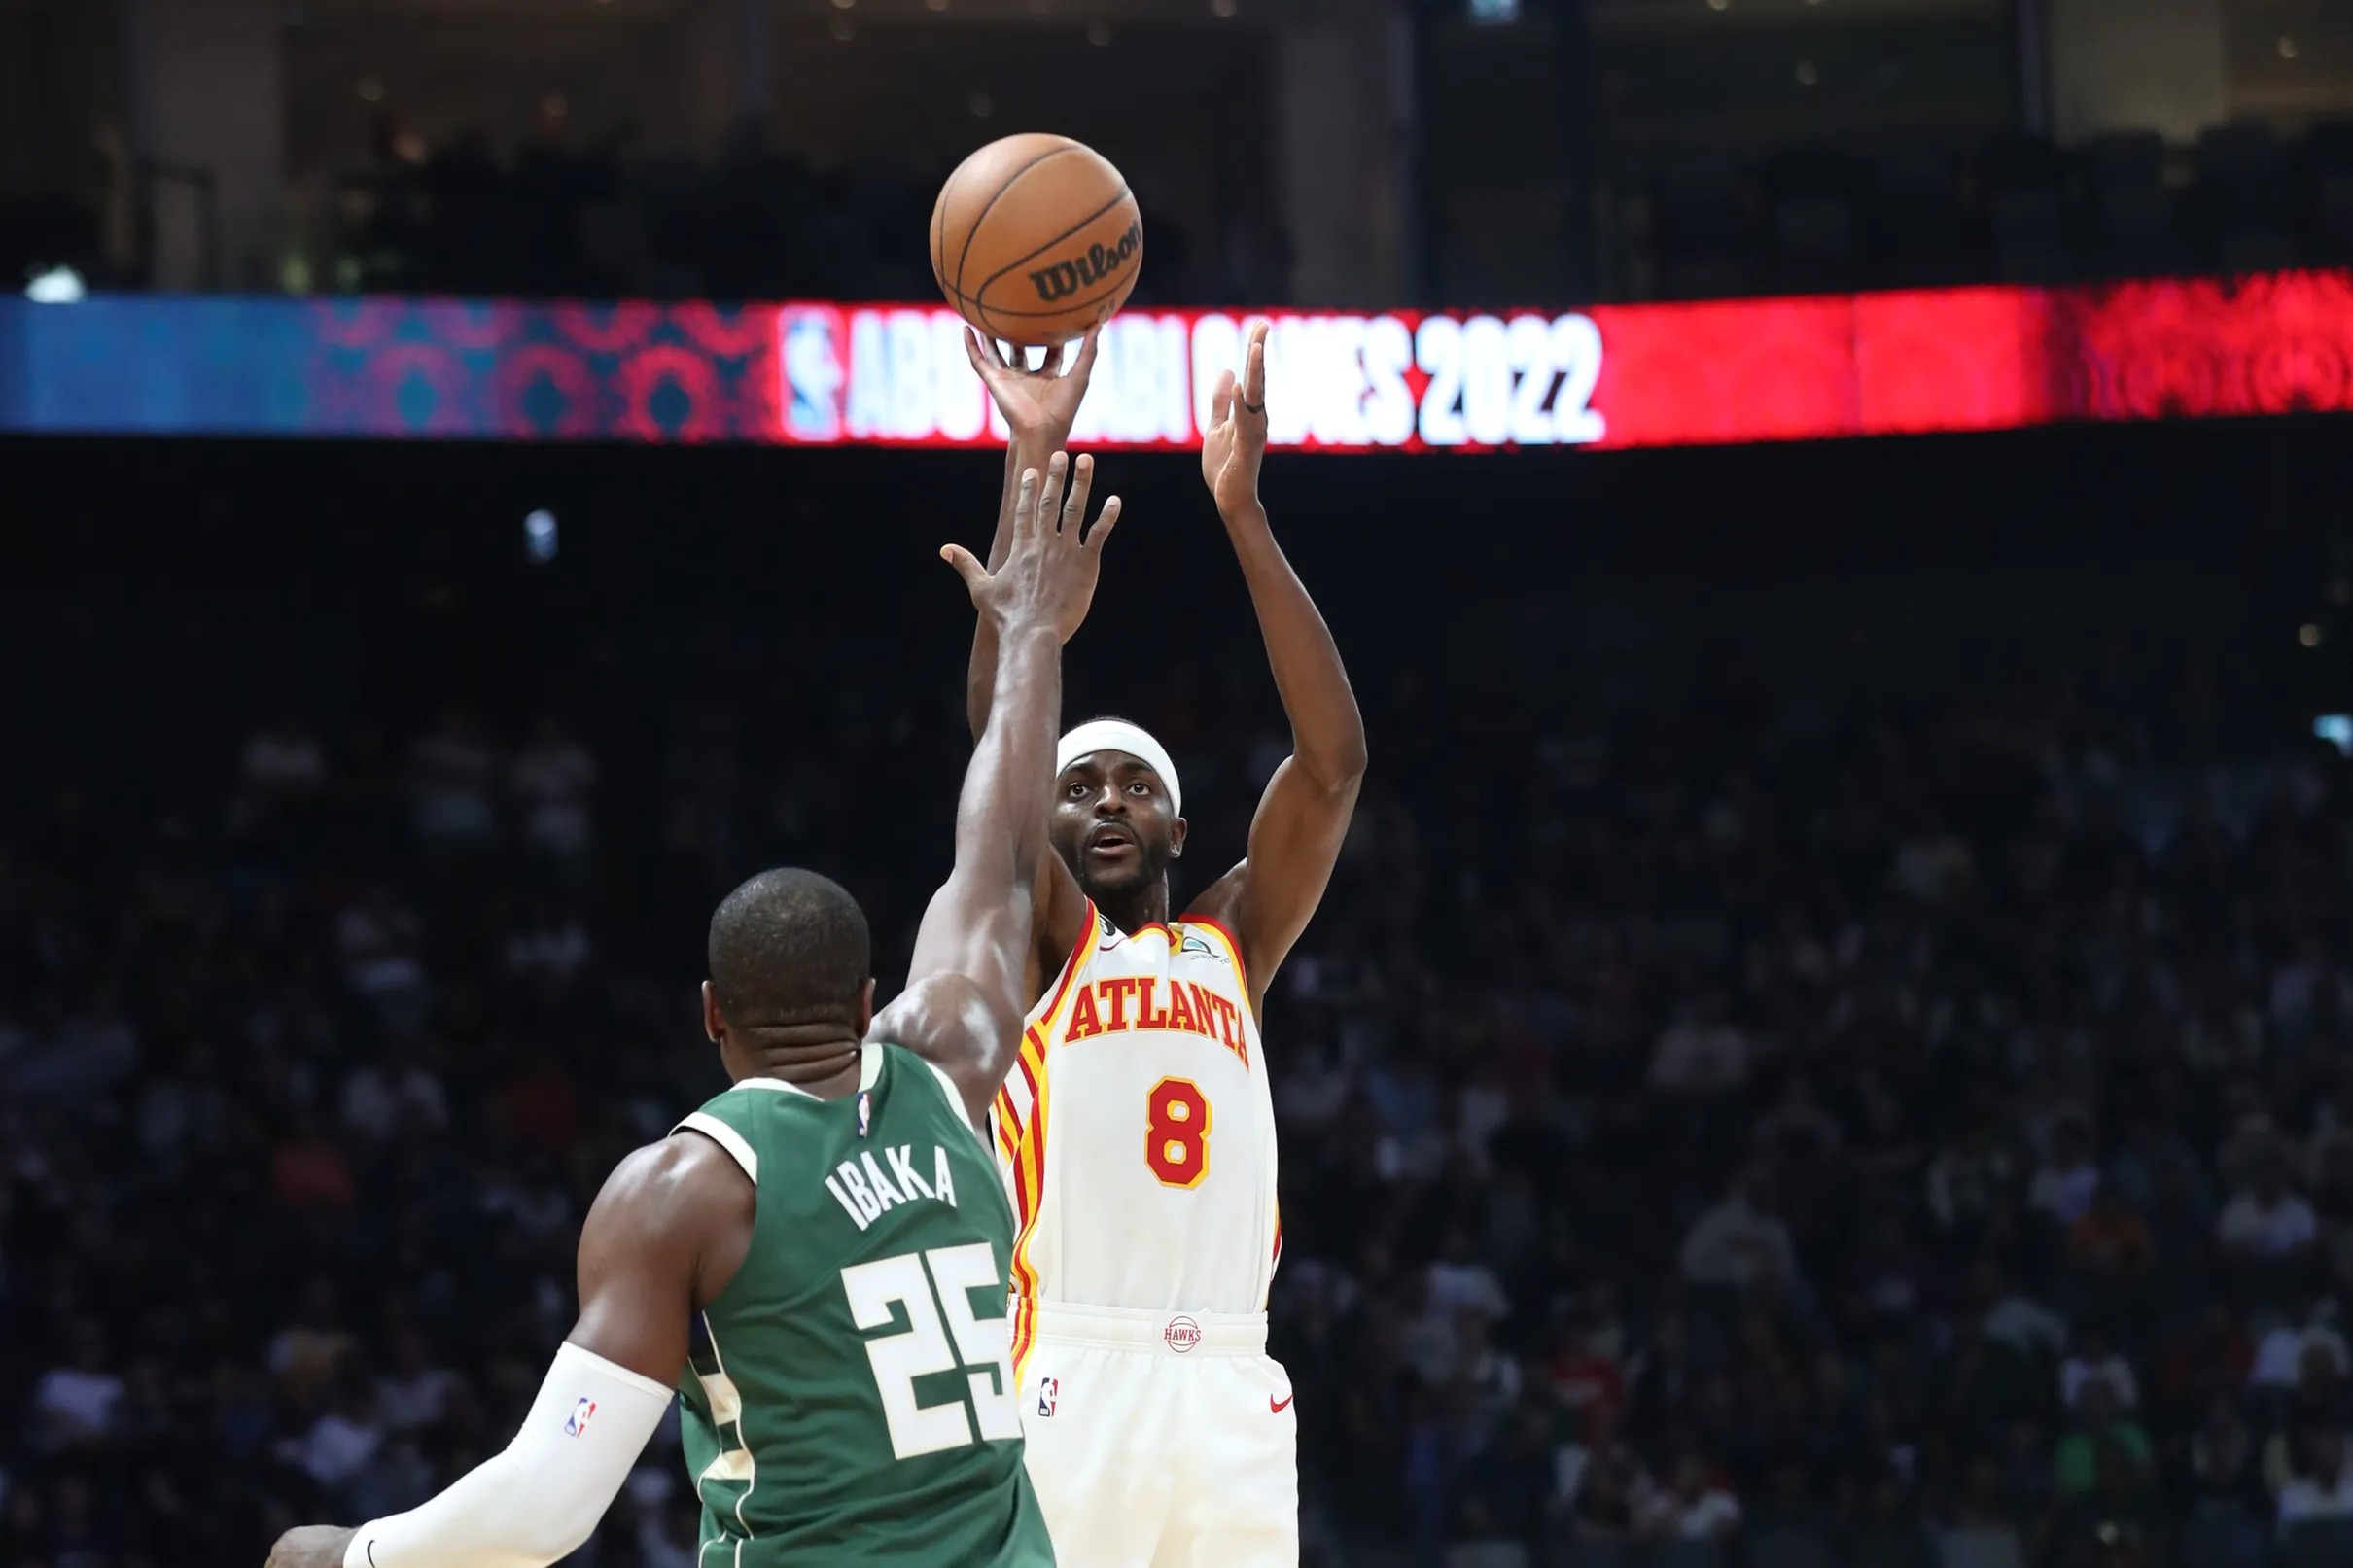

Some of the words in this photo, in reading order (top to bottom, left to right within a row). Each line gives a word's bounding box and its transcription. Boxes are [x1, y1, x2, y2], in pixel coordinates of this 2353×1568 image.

[1028, 219, 1141, 303] Wilson
[1415, 313, 1606, 445] 2022
[1063, 974, 1250, 1074] ATLANTA
[1144, 1075, 1212, 1191] 8
[825, 1143, 958, 1232] IBAKA
[839, 1241, 1024, 1460] 25
[1164, 1327, 1202, 1342] HAWKS
